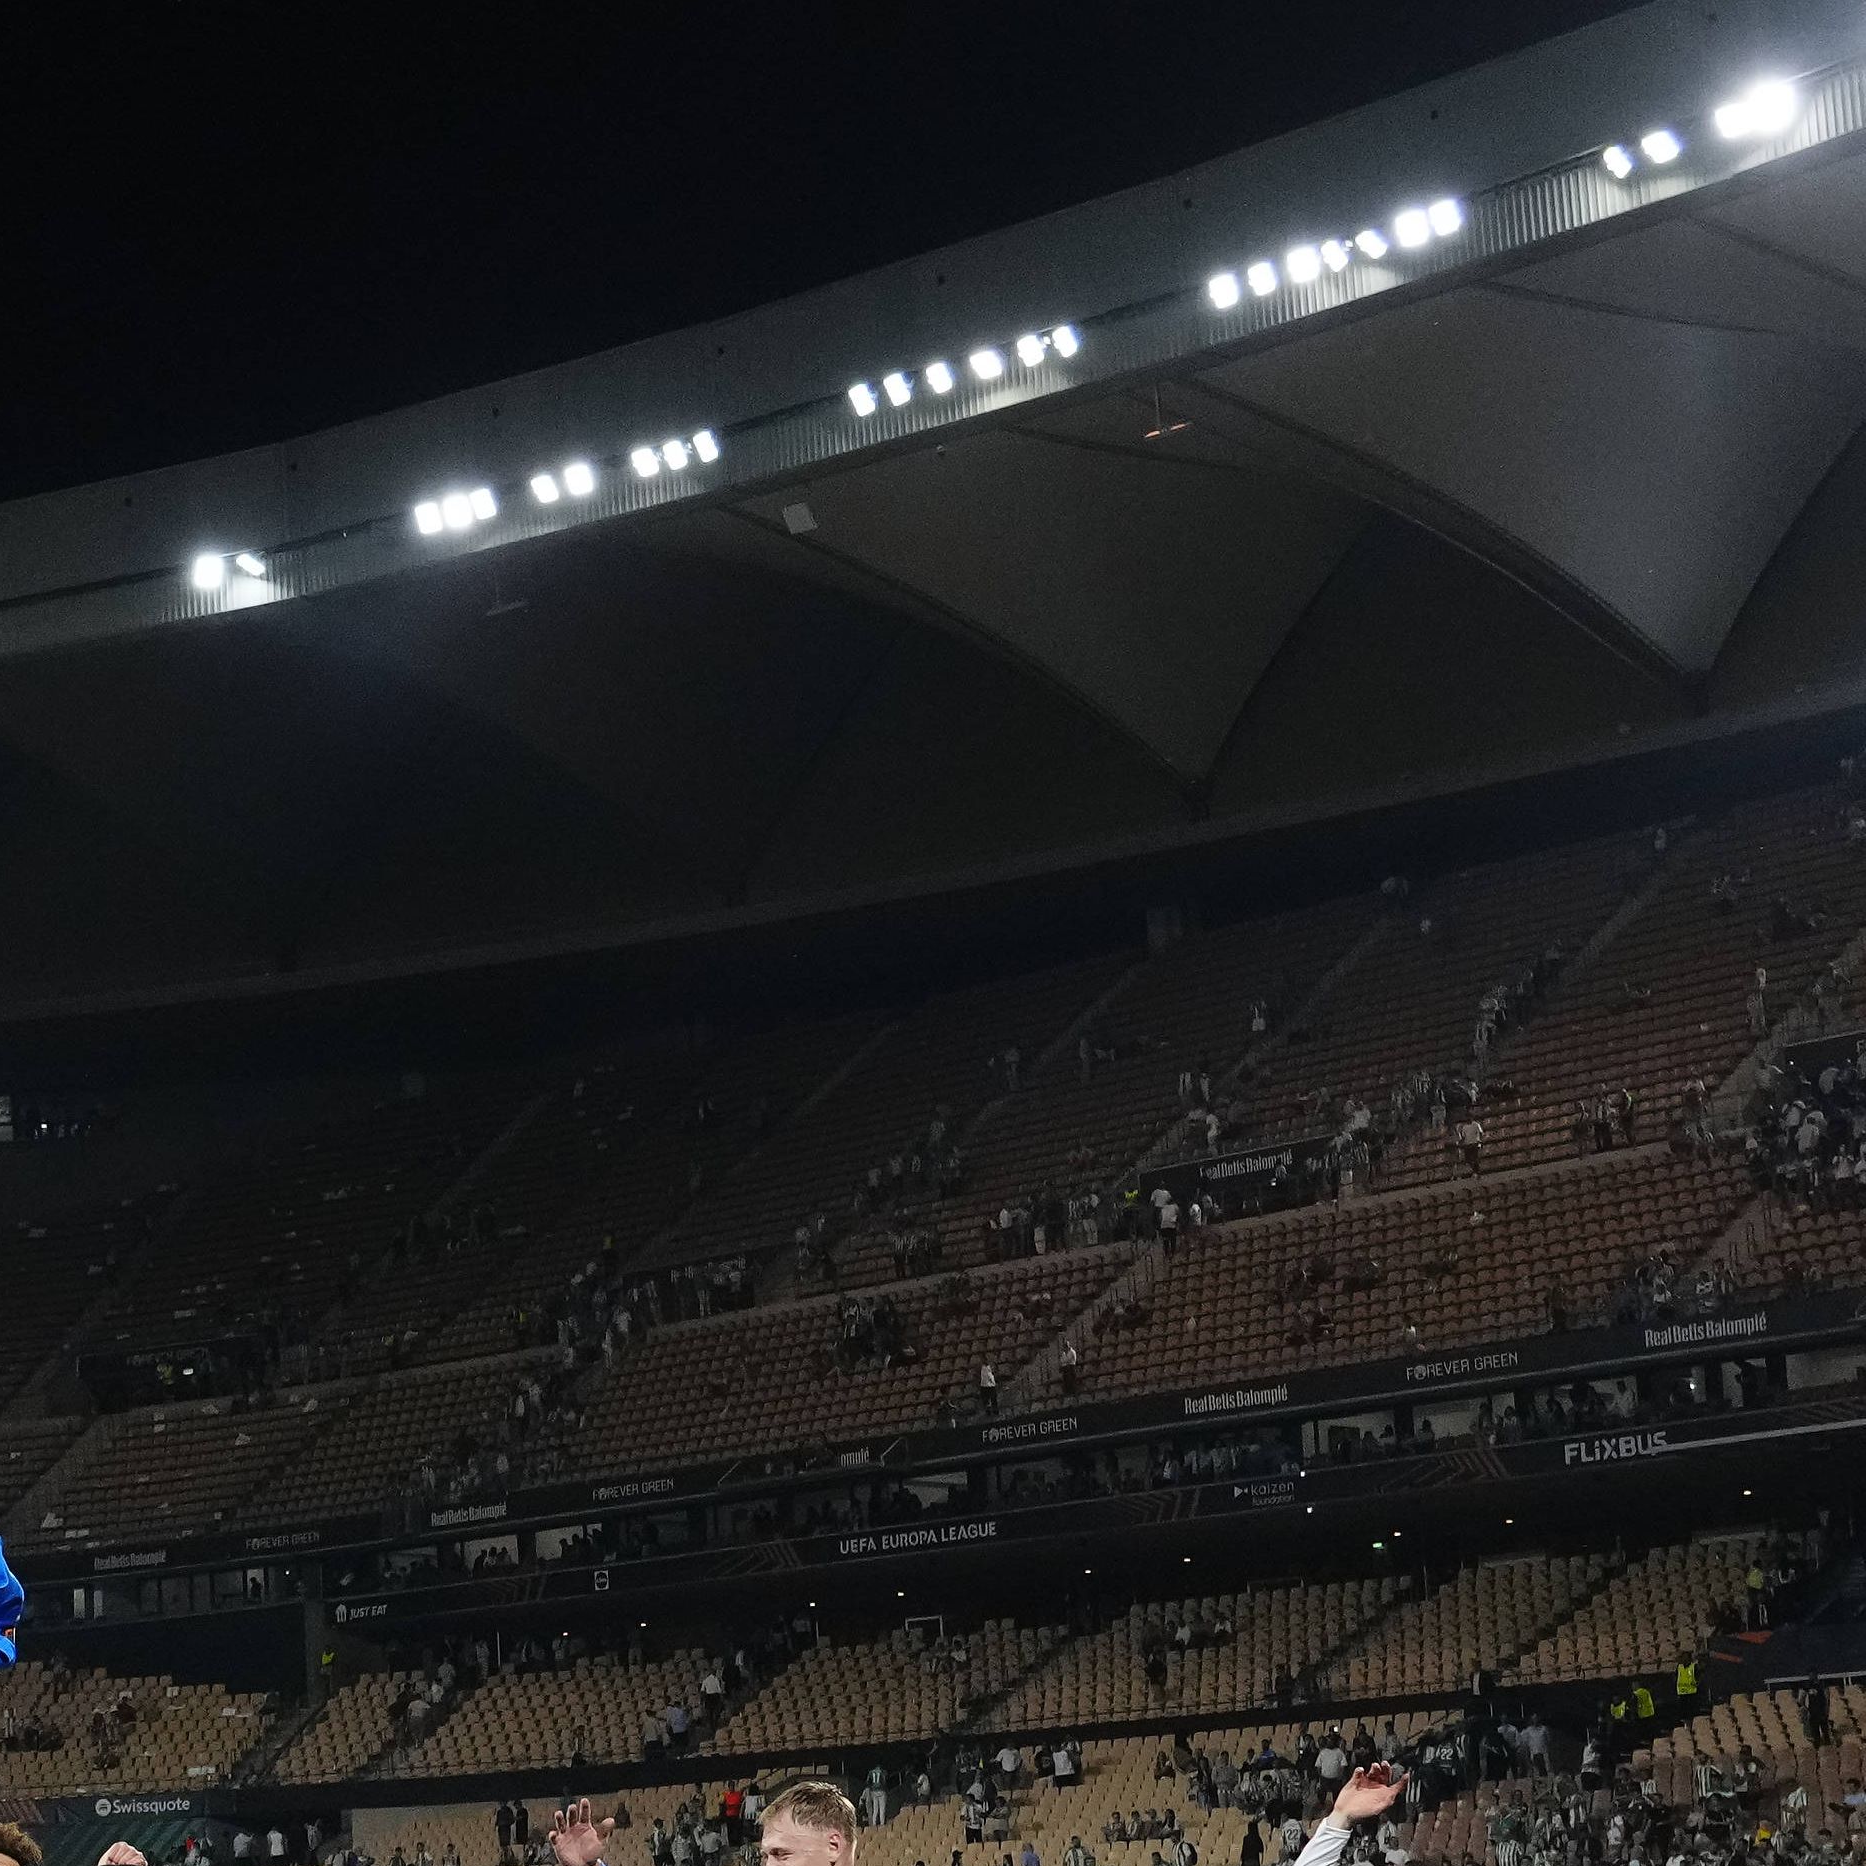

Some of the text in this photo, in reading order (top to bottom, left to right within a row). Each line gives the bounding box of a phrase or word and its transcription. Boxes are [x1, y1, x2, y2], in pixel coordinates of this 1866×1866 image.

[1644, 1327, 1671, 1348] Real
[1670, 1323, 1704, 1344] Betis
[1406, 1351, 1518, 1381] FOREVER GREEN
[982, 1416, 1078, 1443] FOREVER GREEN
[839, 1521, 997, 1555] UEFA EUROPA LEAGUE
[112, 1797, 191, 1816] Swissquote
